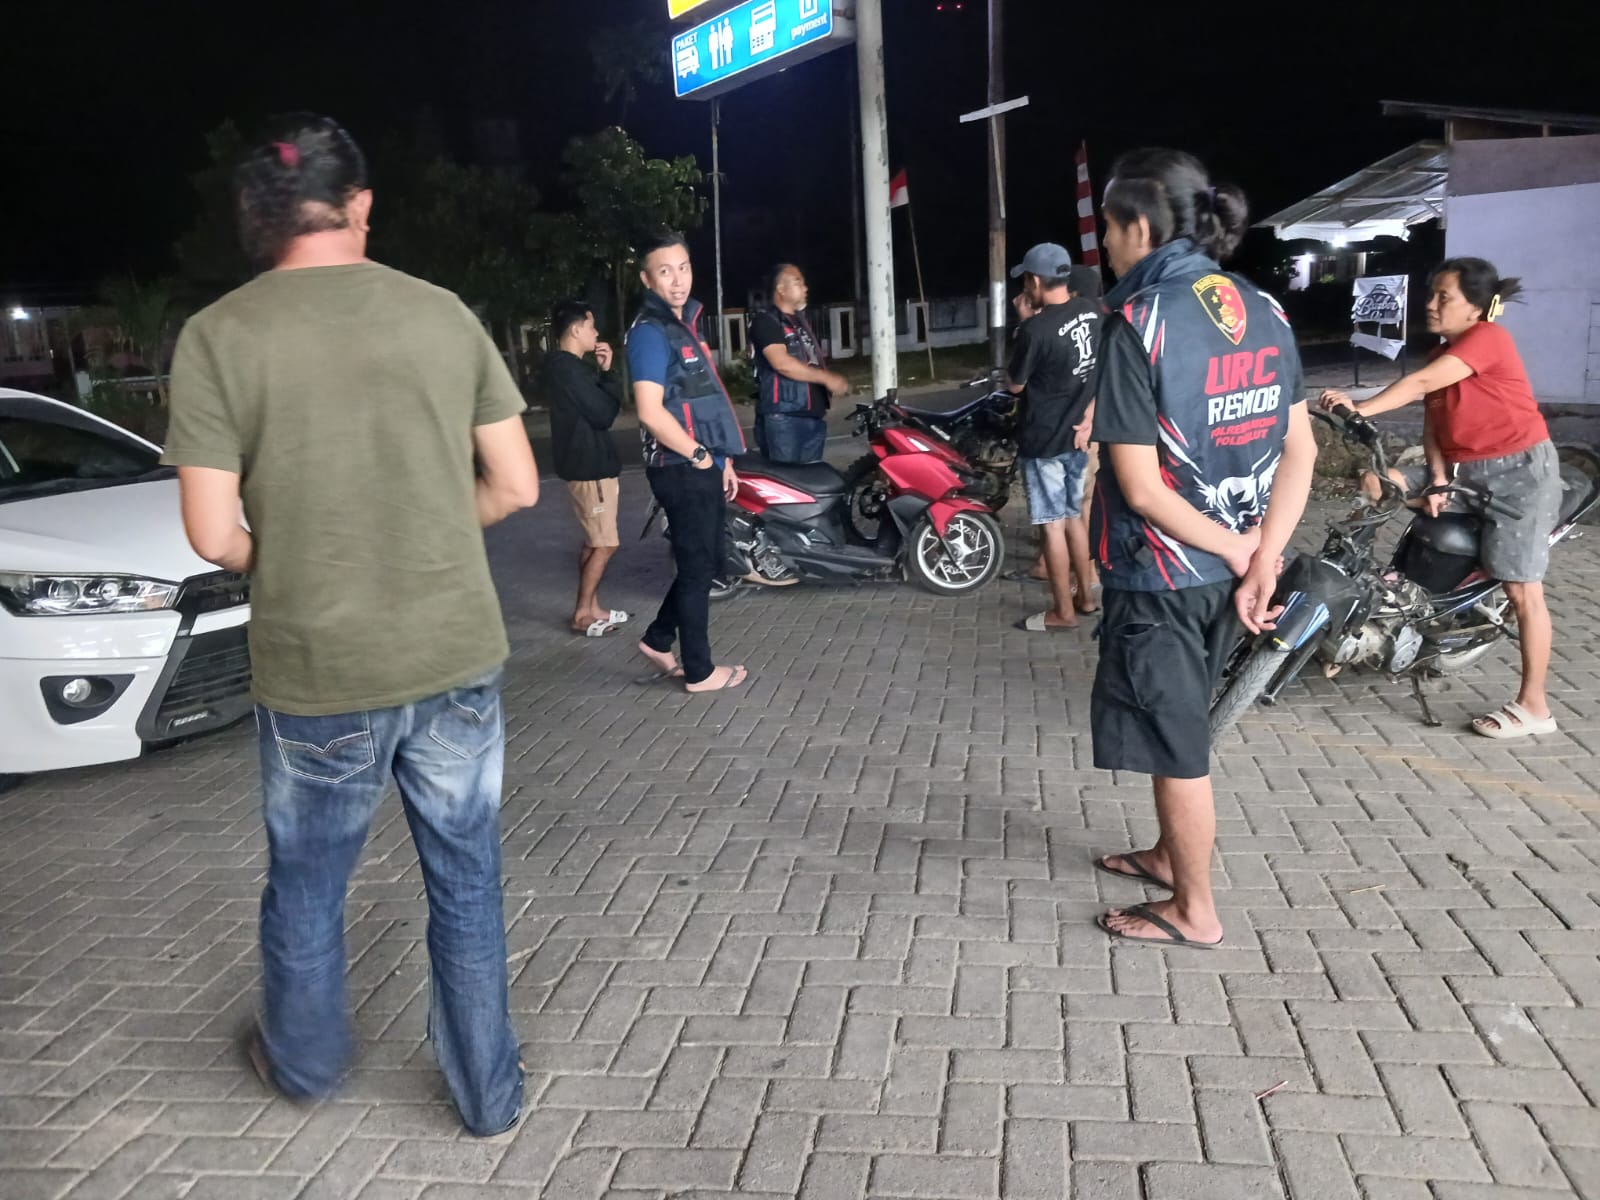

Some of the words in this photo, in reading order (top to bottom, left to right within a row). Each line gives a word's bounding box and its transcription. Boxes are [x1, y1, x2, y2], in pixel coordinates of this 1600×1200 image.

[676, 32, 697, 51] PAKET
[791, 12, 827, 40] payment
[1204, 347, 1280, 395] URC
[1208, 385, 1281, 425] RESMOB
